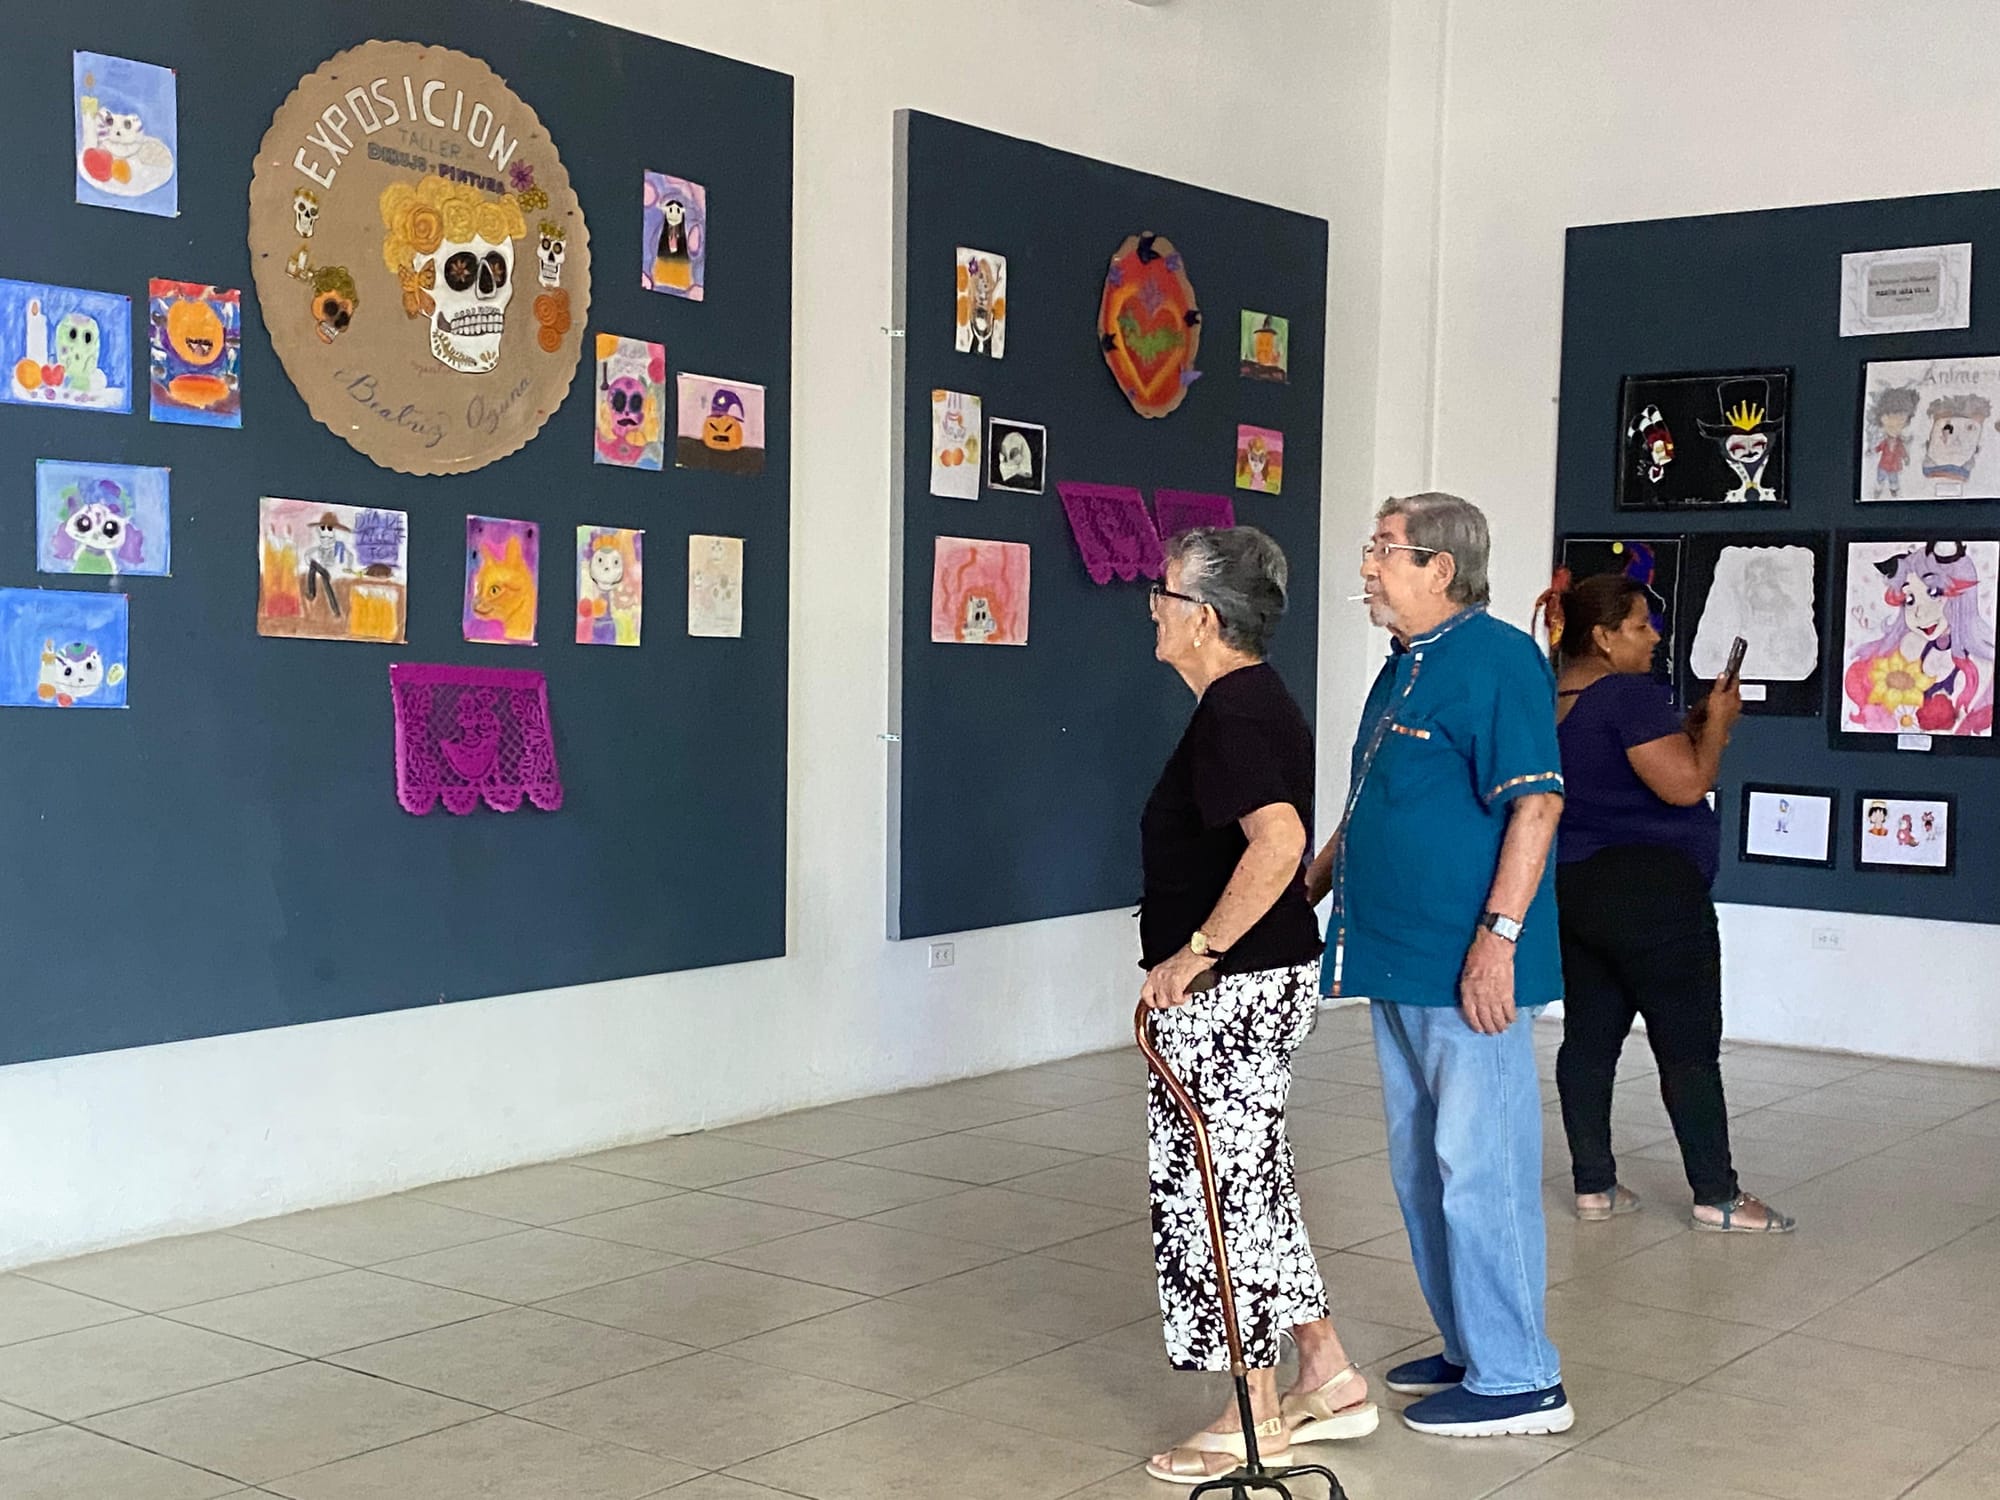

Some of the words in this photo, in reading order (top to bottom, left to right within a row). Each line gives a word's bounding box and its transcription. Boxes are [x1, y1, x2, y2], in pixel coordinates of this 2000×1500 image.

[293, 76, 519, 189] EXPOSICION
[398, 127, 461, 159] TALLER
[1923, 364, 1980, 385] Anime
